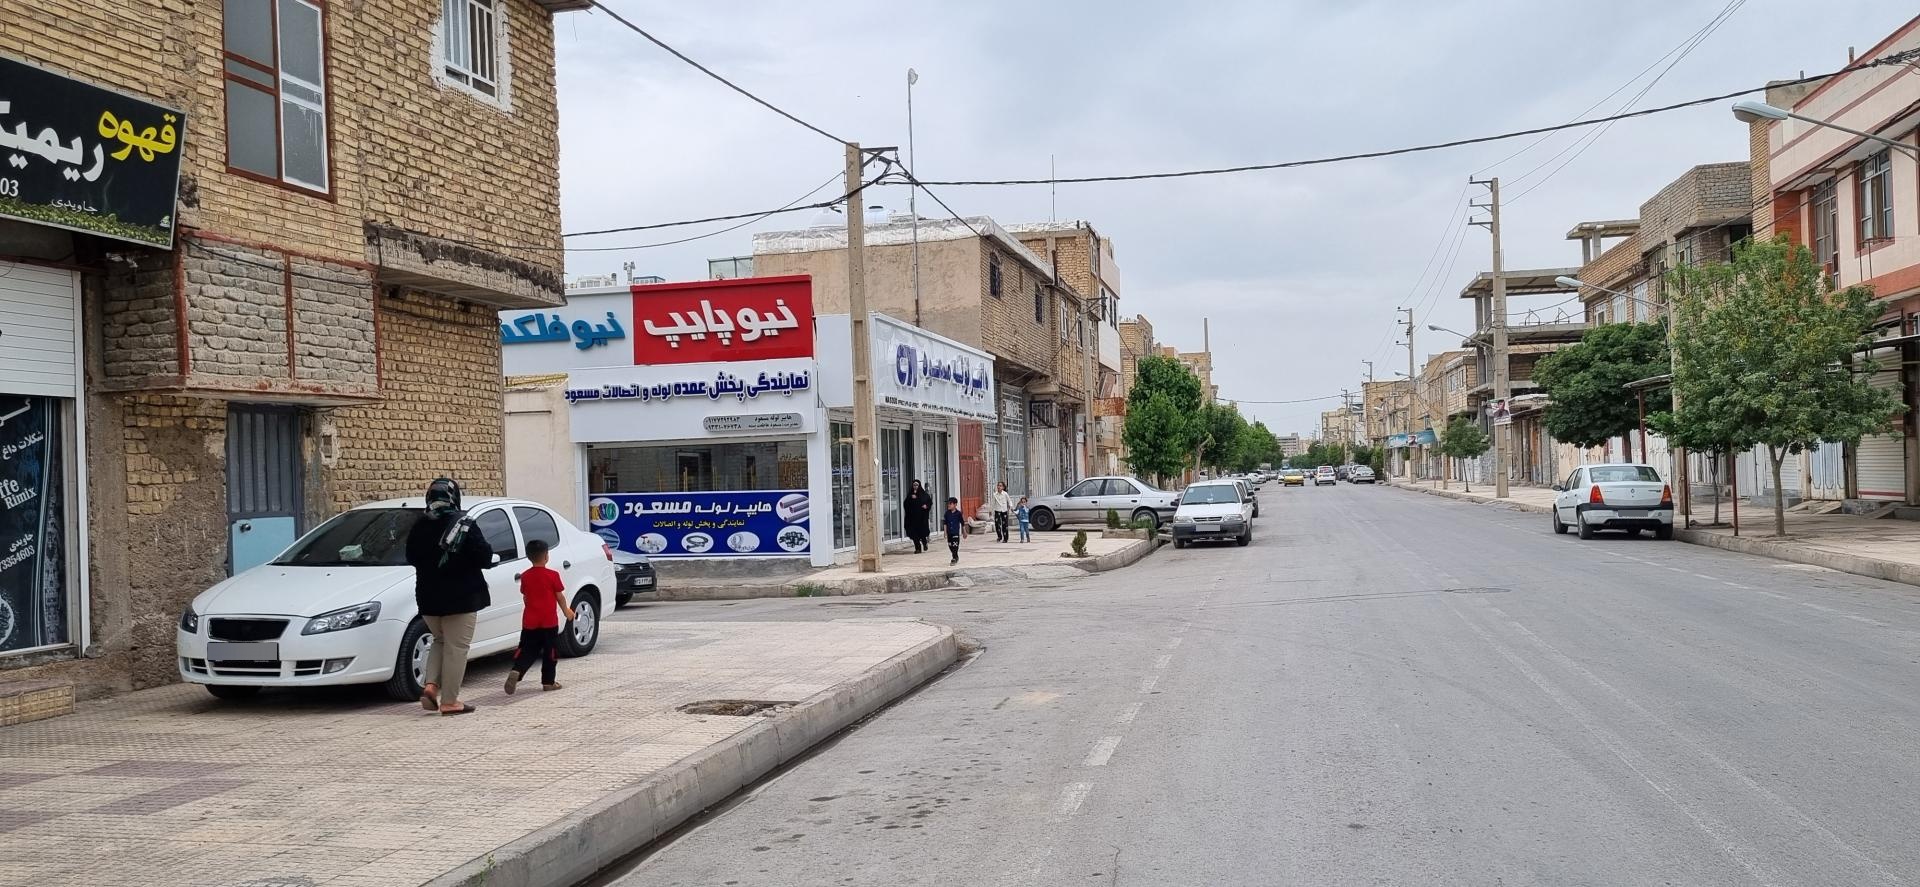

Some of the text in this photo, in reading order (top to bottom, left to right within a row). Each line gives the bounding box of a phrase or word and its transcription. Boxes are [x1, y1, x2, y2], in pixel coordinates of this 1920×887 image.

[98, 110, 177, 162] قهوه
[51, 198, 98, 215] جاویدی
[572, 311, 626, 351] نیو
[643, 298, 799, 348] نیو پایپ
[564, 370, 809, 405] نمایندگی پخش عمده لوله و اتصالات مسعود
[2, 431, 44, 460] شکلات داغ
[4, 487, 38, 510] Rimix
[623, 501, 773, 518] هایپر لوله مسعود
[652, 520, 677, 529] اتصالات
[682, 520, 694, 529] لوله
[695, 520, 711, 529] پخش
[711, 521, 716, 529] و
[717, 519, 745, 530] نمایندگی
[9, 533, 34, 552] جاویدی
